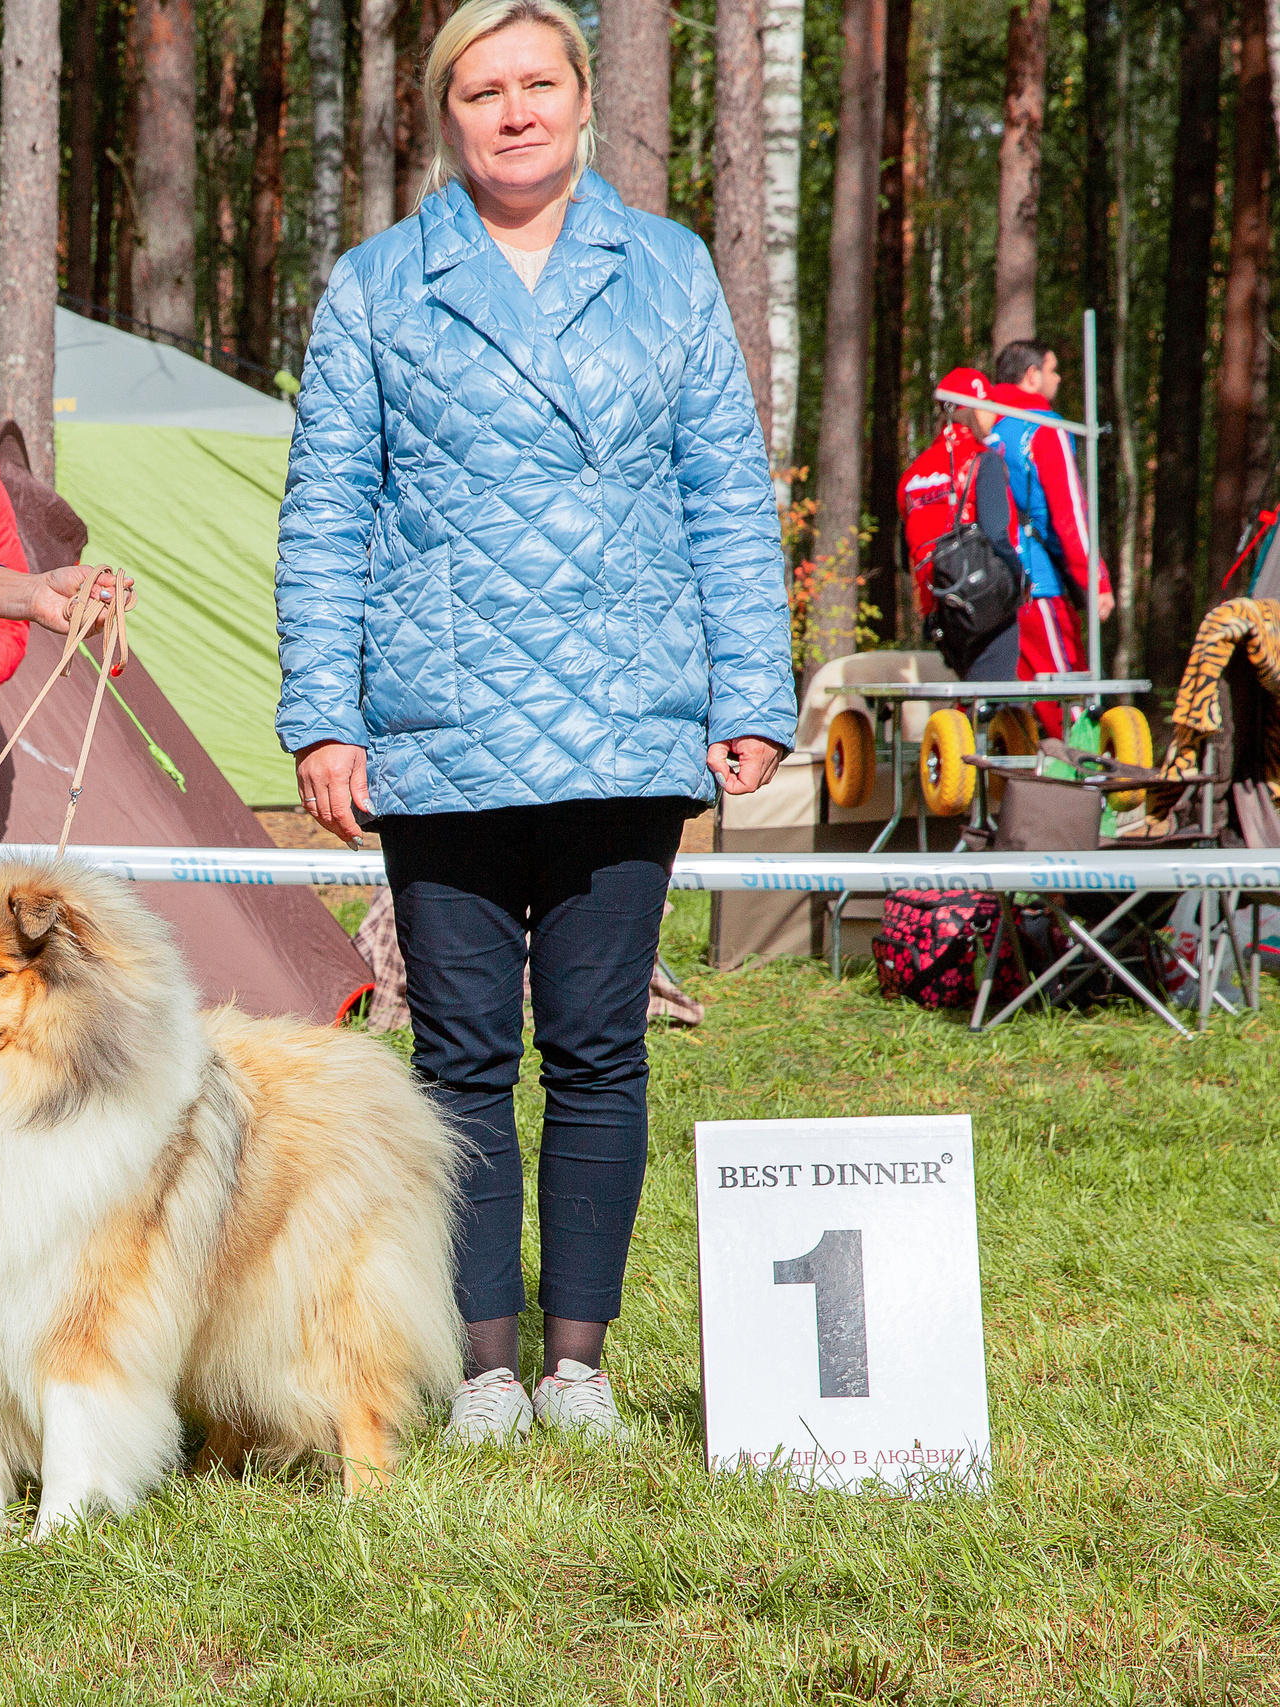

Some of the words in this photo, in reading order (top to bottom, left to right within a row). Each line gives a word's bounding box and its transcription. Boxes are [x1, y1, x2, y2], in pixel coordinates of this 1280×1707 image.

[718, 1164, 803, 1189] BEST
[811, 1160, 947, 1187] DINNER
[773, 1229, 870, 1398] 1
[853, 1450, 868, 1465] В
